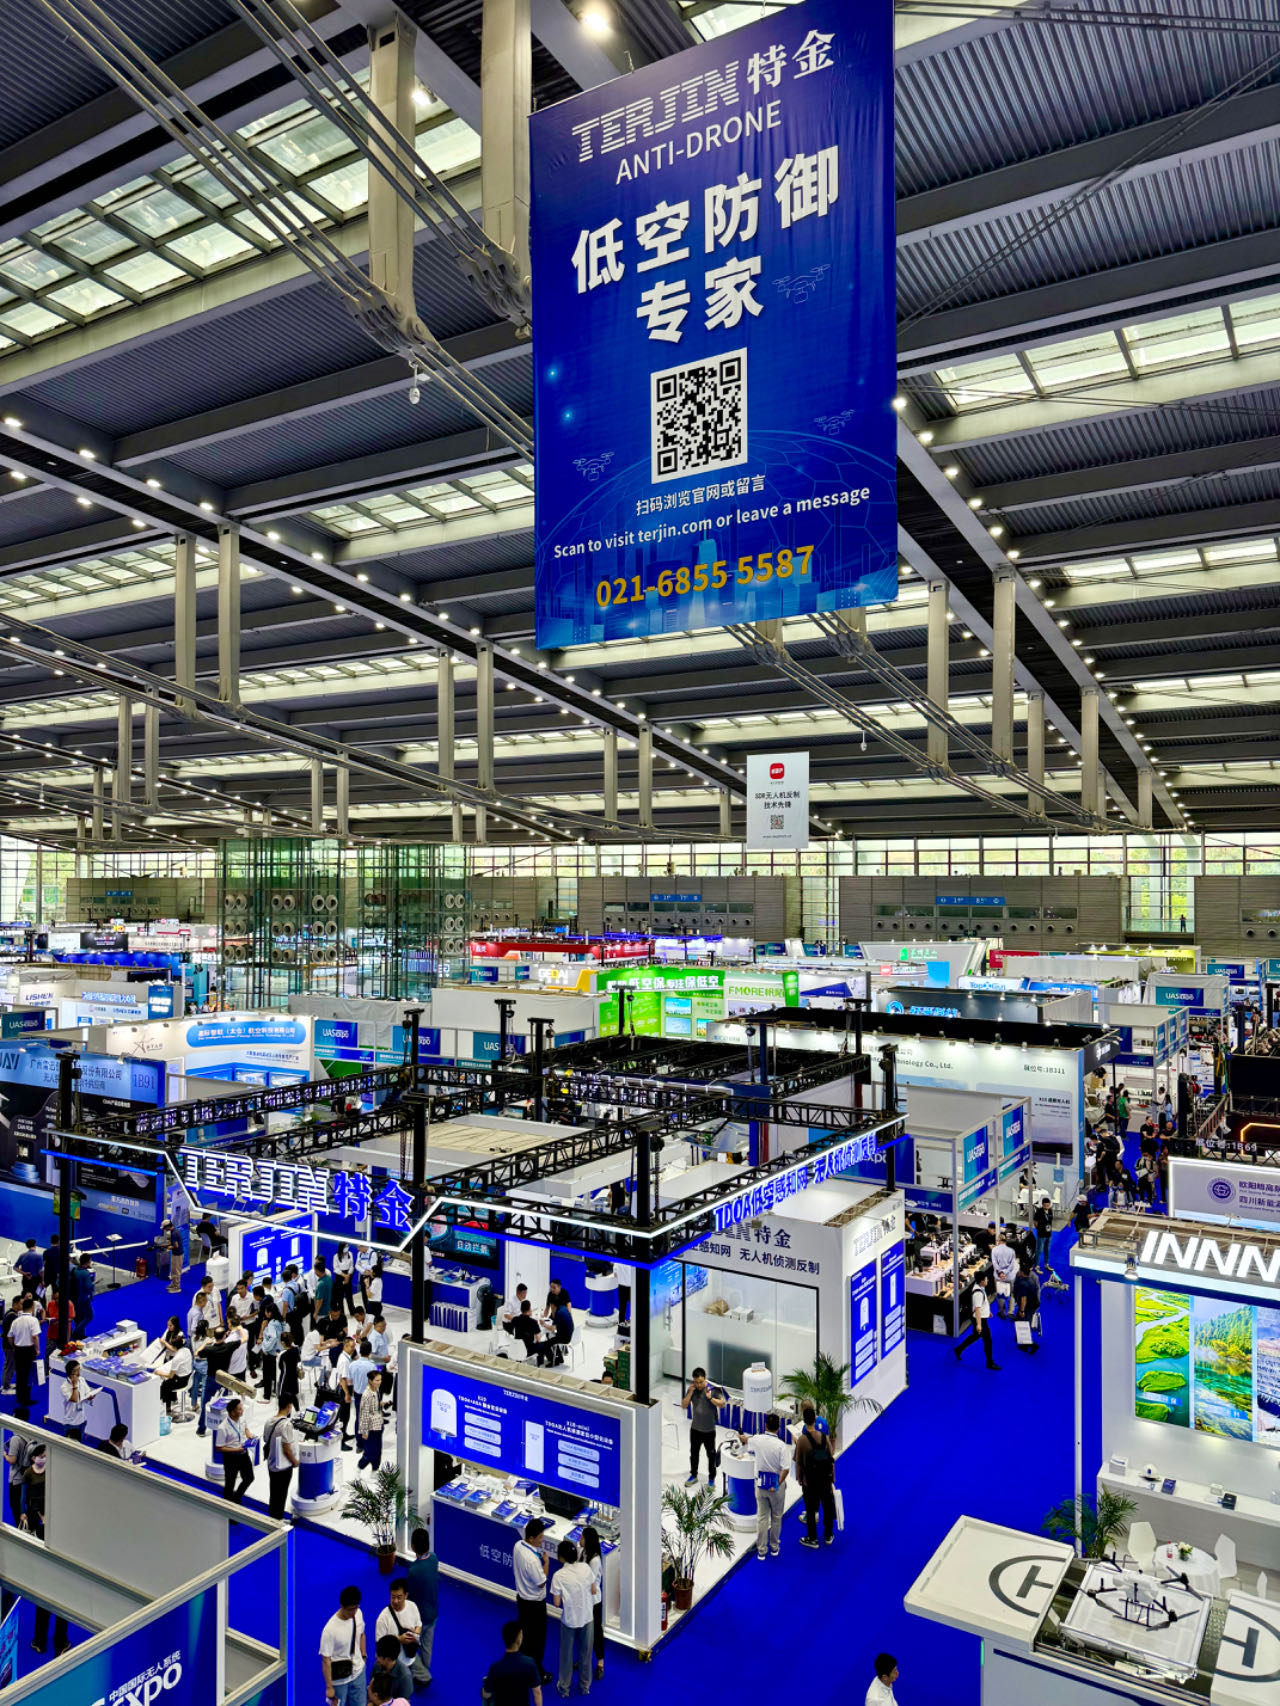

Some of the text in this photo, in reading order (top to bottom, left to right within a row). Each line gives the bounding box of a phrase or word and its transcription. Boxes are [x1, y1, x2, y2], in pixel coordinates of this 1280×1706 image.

[572, 29, 836, 163] TERJIN 特金
[616, 100, 782, 185] ANTI-DRONE
[571, 145, 839, 294] 低空防御
[636, 255, 764, 343] 专家
[553, 487, 870, 559] Scan to visit terjin.com or leave a message
[636, 474, 766, 516] 扫码浏览官网或留言
[596, 545, 814, 607] 021-6855 5587
[180, 1146, 415, 1232] TERJIN 特金
